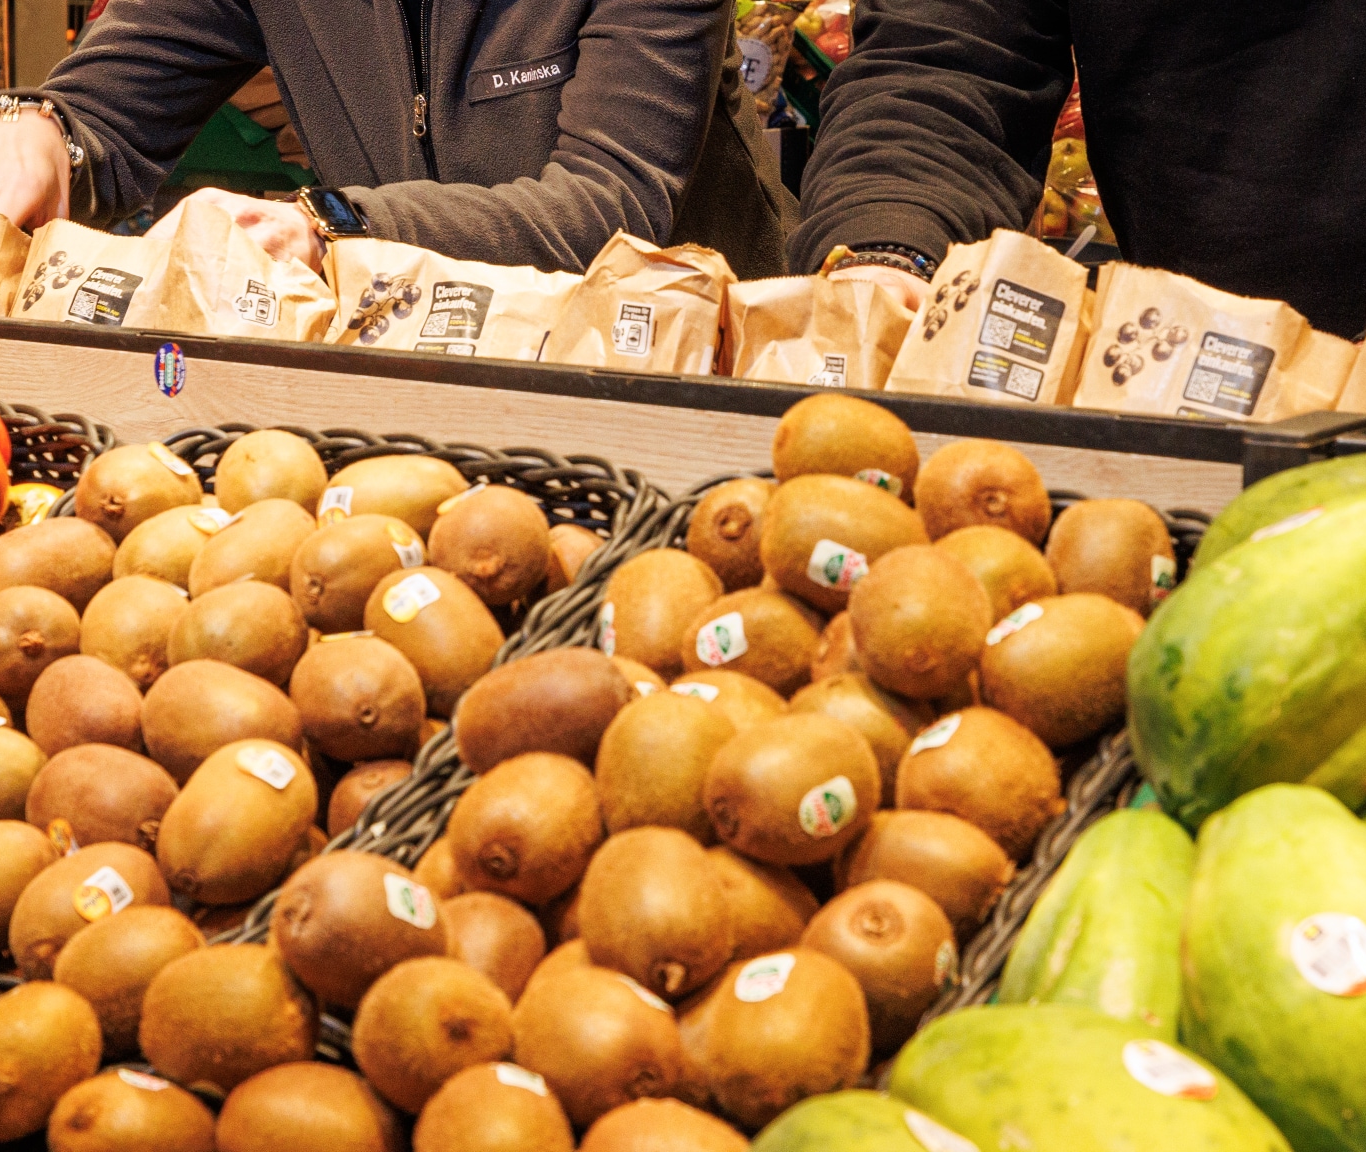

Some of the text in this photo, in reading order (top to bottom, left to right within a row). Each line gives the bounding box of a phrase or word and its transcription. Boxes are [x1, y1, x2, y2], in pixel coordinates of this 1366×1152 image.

[492, 74, 509, 89] D.
[435, 285, 473, 299] Cleverer
[996, 283, 1044, 312] Cleverer
[1203, 335, 1253, 360] Cleverer
